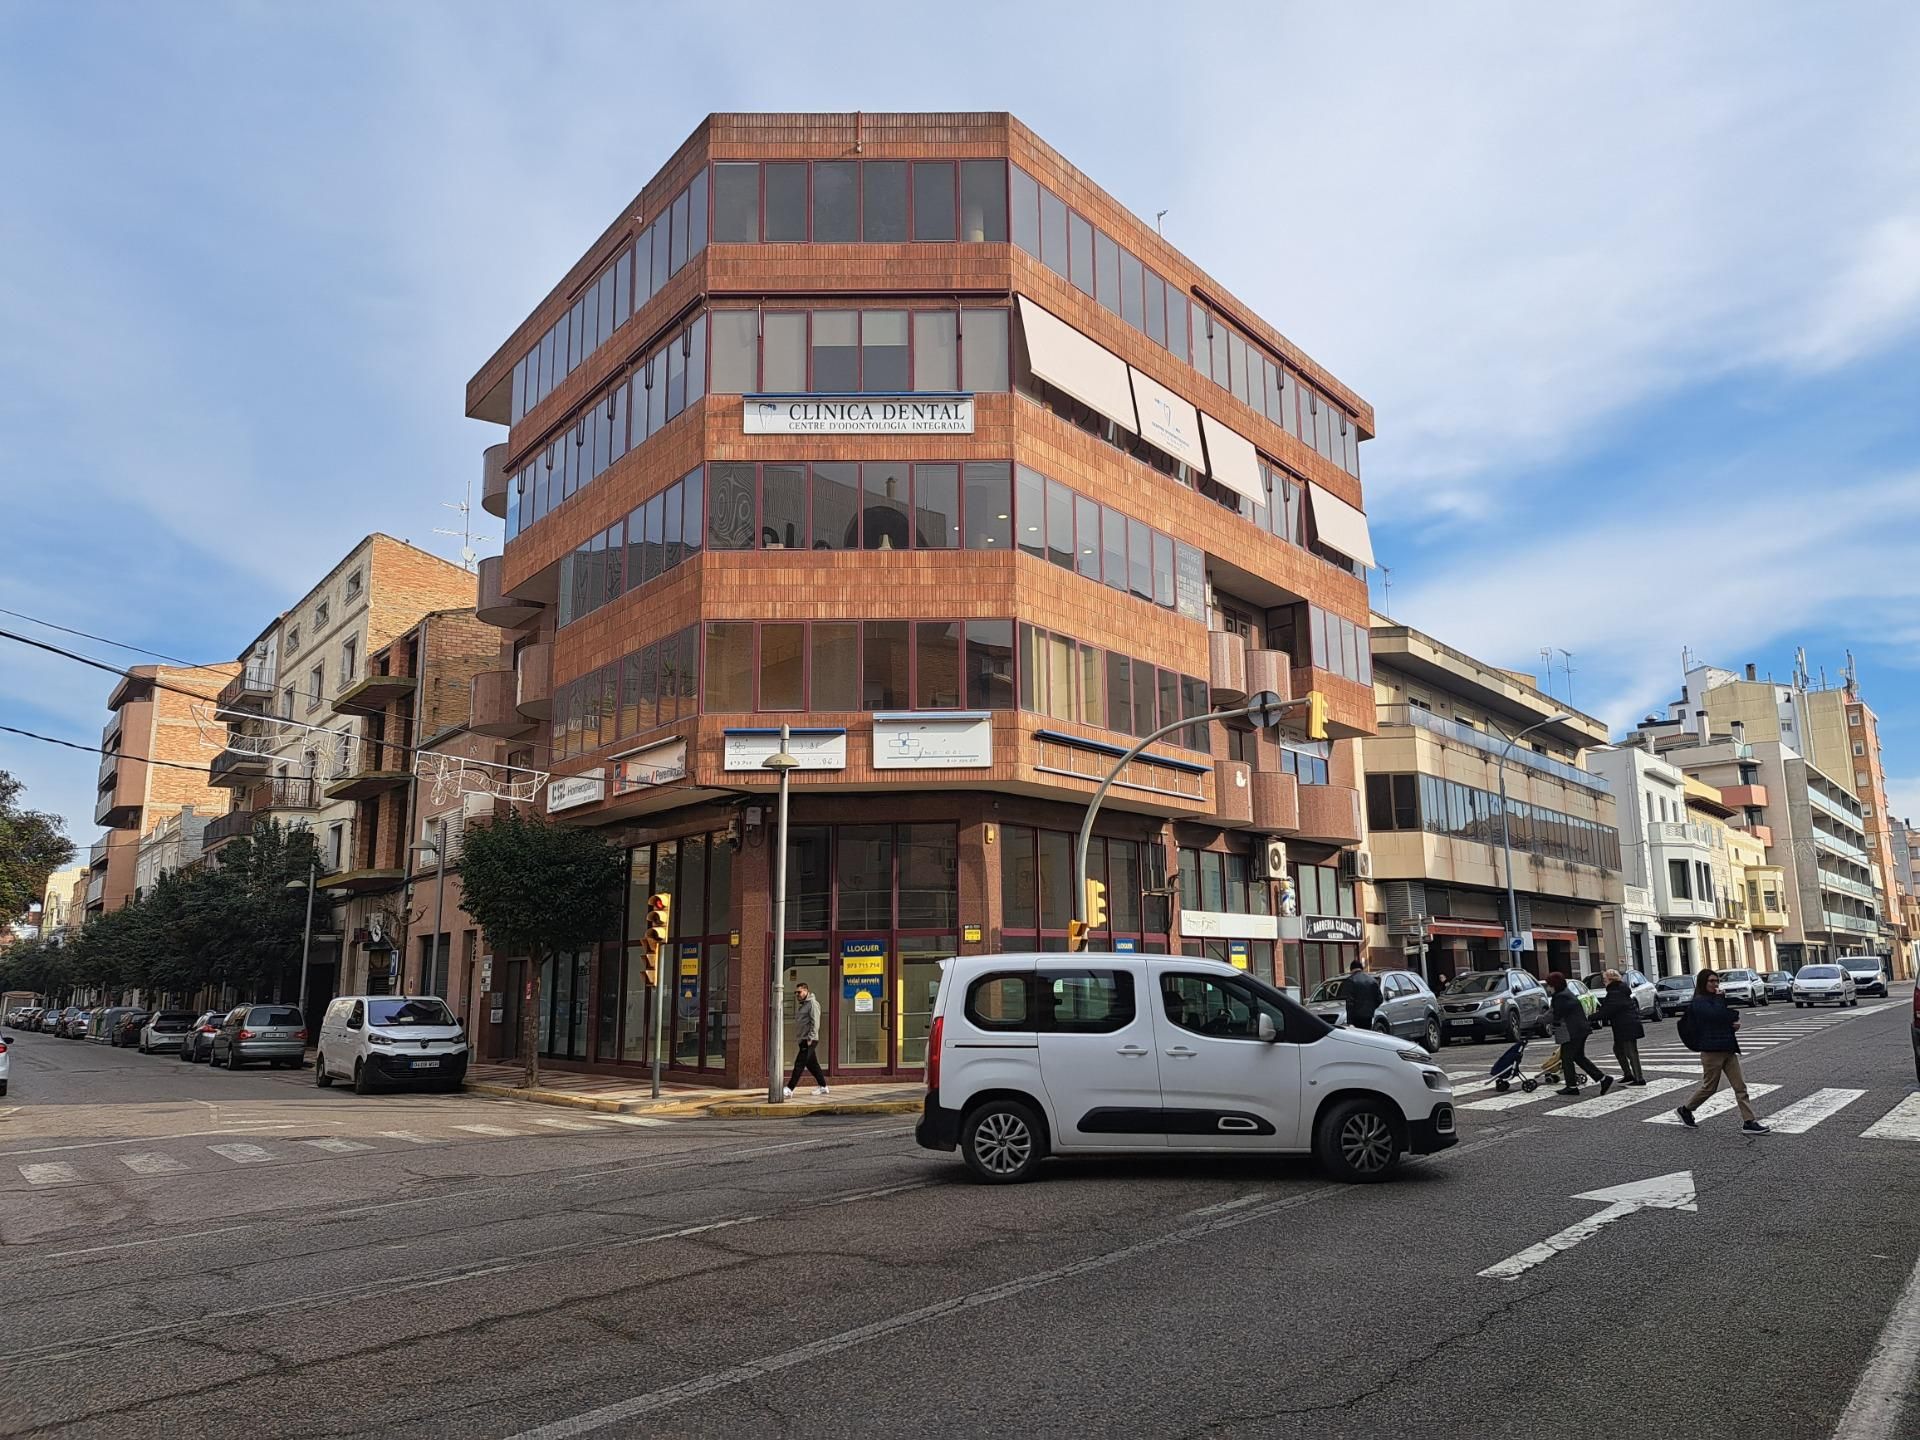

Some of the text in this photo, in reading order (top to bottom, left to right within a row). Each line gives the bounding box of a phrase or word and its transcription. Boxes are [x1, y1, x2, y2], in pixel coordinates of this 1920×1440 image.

[882, 403, 965, 420] DENTAL
[788, 422, 825, 430] CENTRE
[912, 422, 966, 430] INTEGRADA
